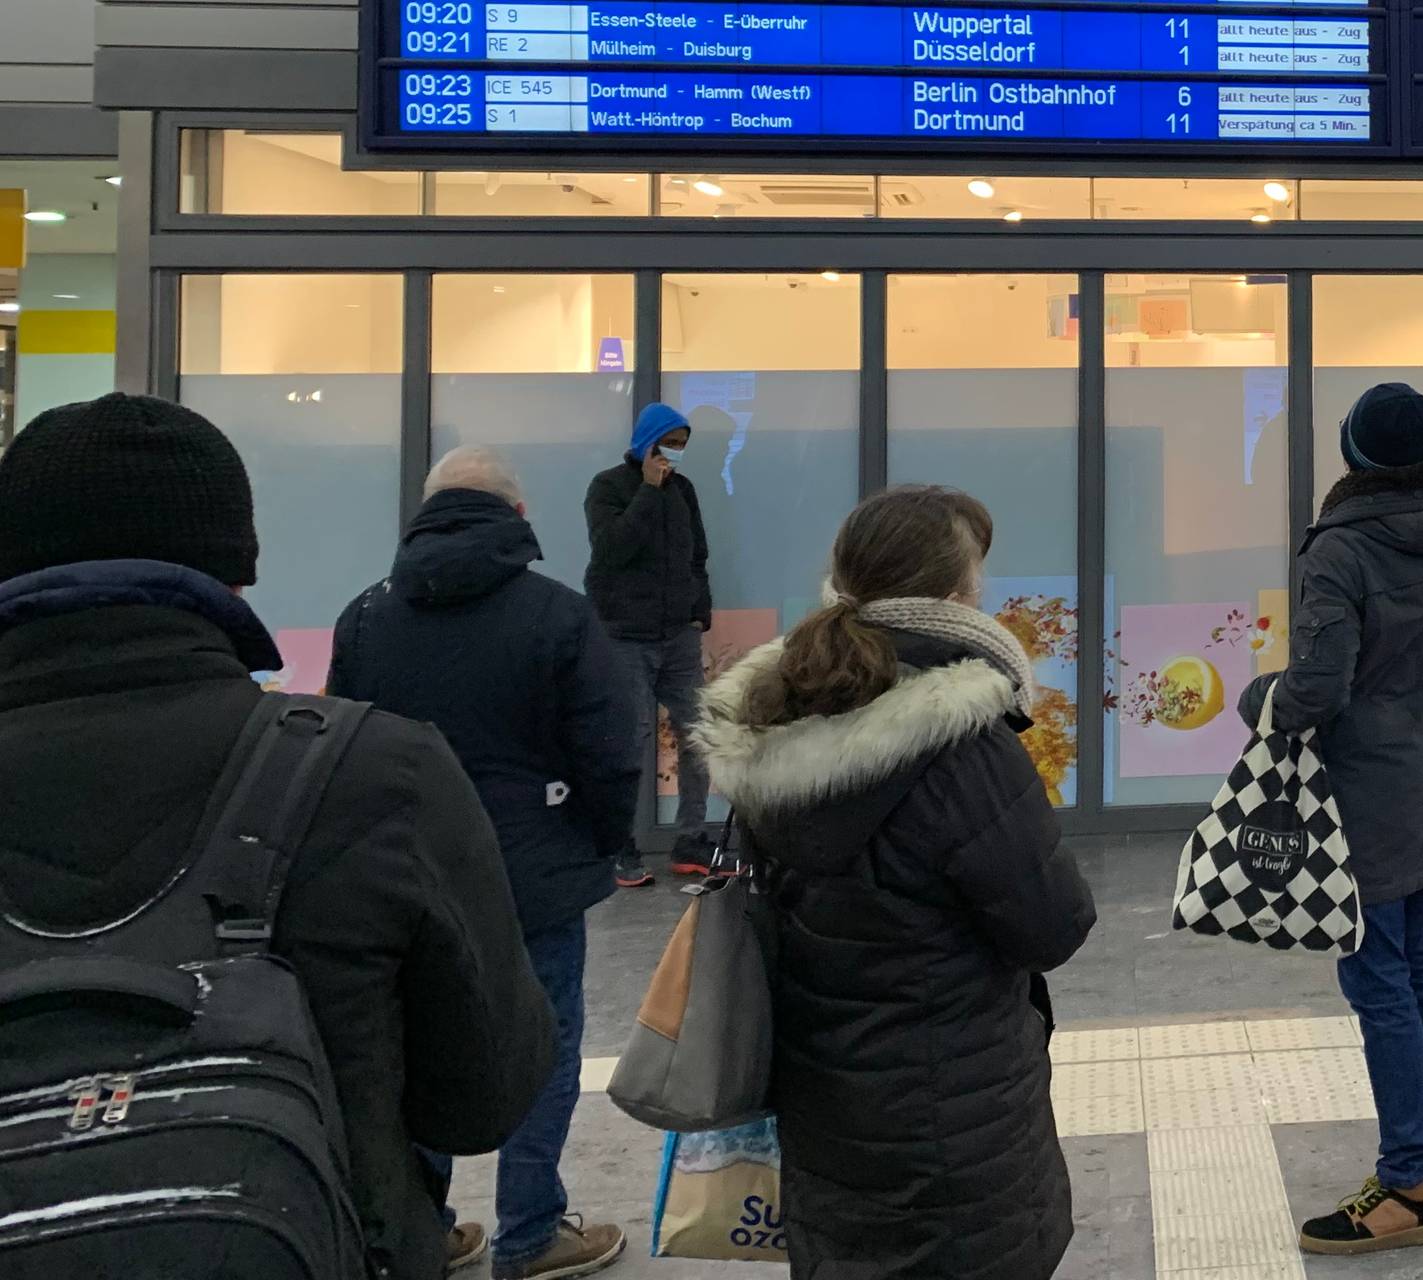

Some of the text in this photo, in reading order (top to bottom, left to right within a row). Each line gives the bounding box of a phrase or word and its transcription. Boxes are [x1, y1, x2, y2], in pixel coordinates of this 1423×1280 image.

[406, 2, 472, 24] 09:20
[488, 9, 518, 23] S 9
[591, 14, 696, 29] Essen-Steele
[724, 14, 808, 30] E-Überruhr
[913, 12, 1033, 36] Wuppertal
[1165, 19, 1189, 39] 11
[1249, 25, 1288, 36] heute
[1294, 27, 1317, 36] aus
[1337, 26, 1361, 39] Zug
[406, 31, 470, 52] 09:21
[488, 38, 528, 52] RE 2
[591, 40, 656, 56] Mülheim
[684, 42, 752, 59] Duisburg
[913, 39, 1035, 63] Düsseldorf
[1179, 47, 1189, 65] 1
[1249, 52, 1288, 63] heute
[1294, 54, 1317, 63] aus
[1338, 53, 1361, 66] Zug
[406, 74, 471, 96] 09:23
[488, 80, 552, 95] ICE 545
[591, 83, 667, 99] Dortmund
[695, 84, 742, 100] Hamm
[751, 84, 811, 101] (Westf)
[913, 82, 1116, 106] Berlin Ostbahnhof
[1178, 87, 1190, 107] 6
[1250, 93, 1289, 103] heute
[1295, 95, 1318, 104] aus
[1338, 94, 1361, 106] Zug
[406, 104, 471, 124] 09:25
[488, 109, 517, 123] S 1
[591, 110, 704, 130] Watt.-Höntrop
[731, 113, 792, 129] Bochum
[913, 110, 1025, 132] Dortmund
[1165, 114, 1190, 133] 11
[1299, 122, 1315, 131] ca
[1320, 121, 1327, 131] 5
[1333, 121, 1356, 131] Min.
